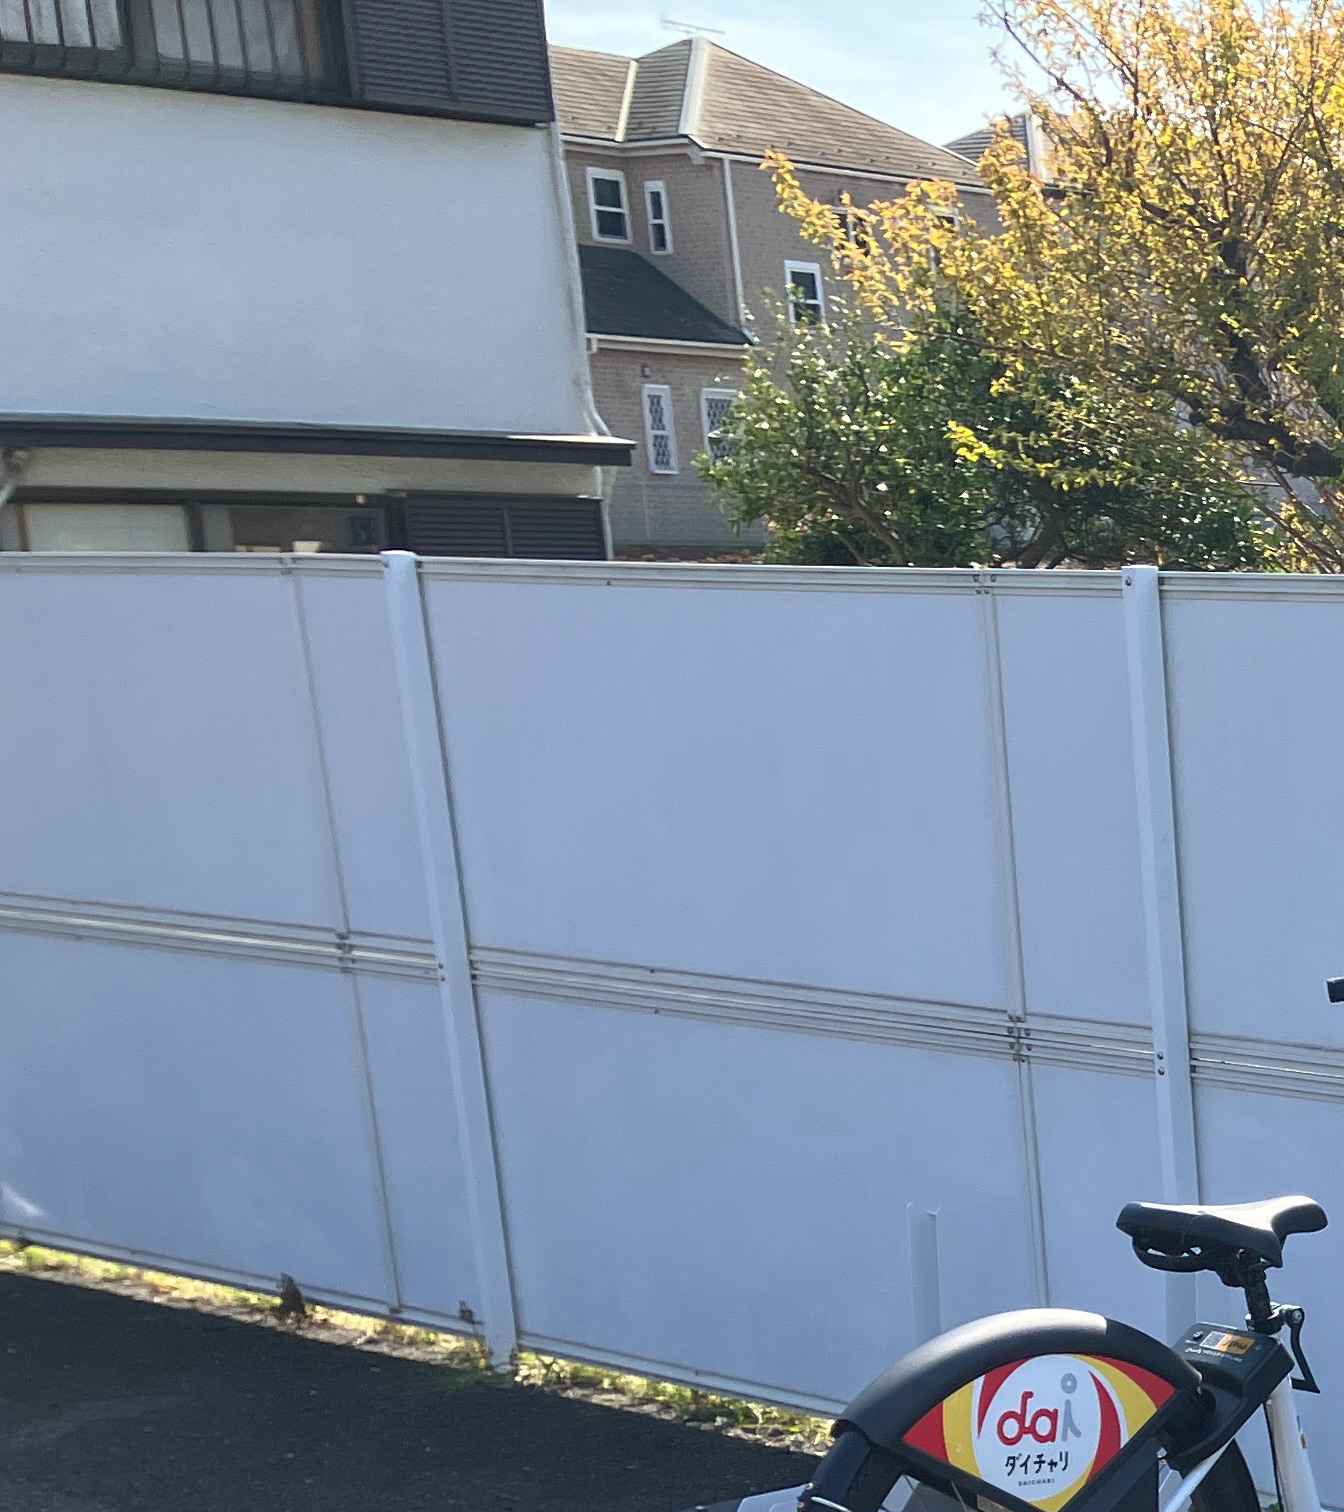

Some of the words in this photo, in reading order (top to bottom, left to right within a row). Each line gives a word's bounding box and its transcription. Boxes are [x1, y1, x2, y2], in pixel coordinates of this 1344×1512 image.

[997, 1373, 1081, 1446] dai
[1005, 1451, 1069, 1476] ダイチャリ
